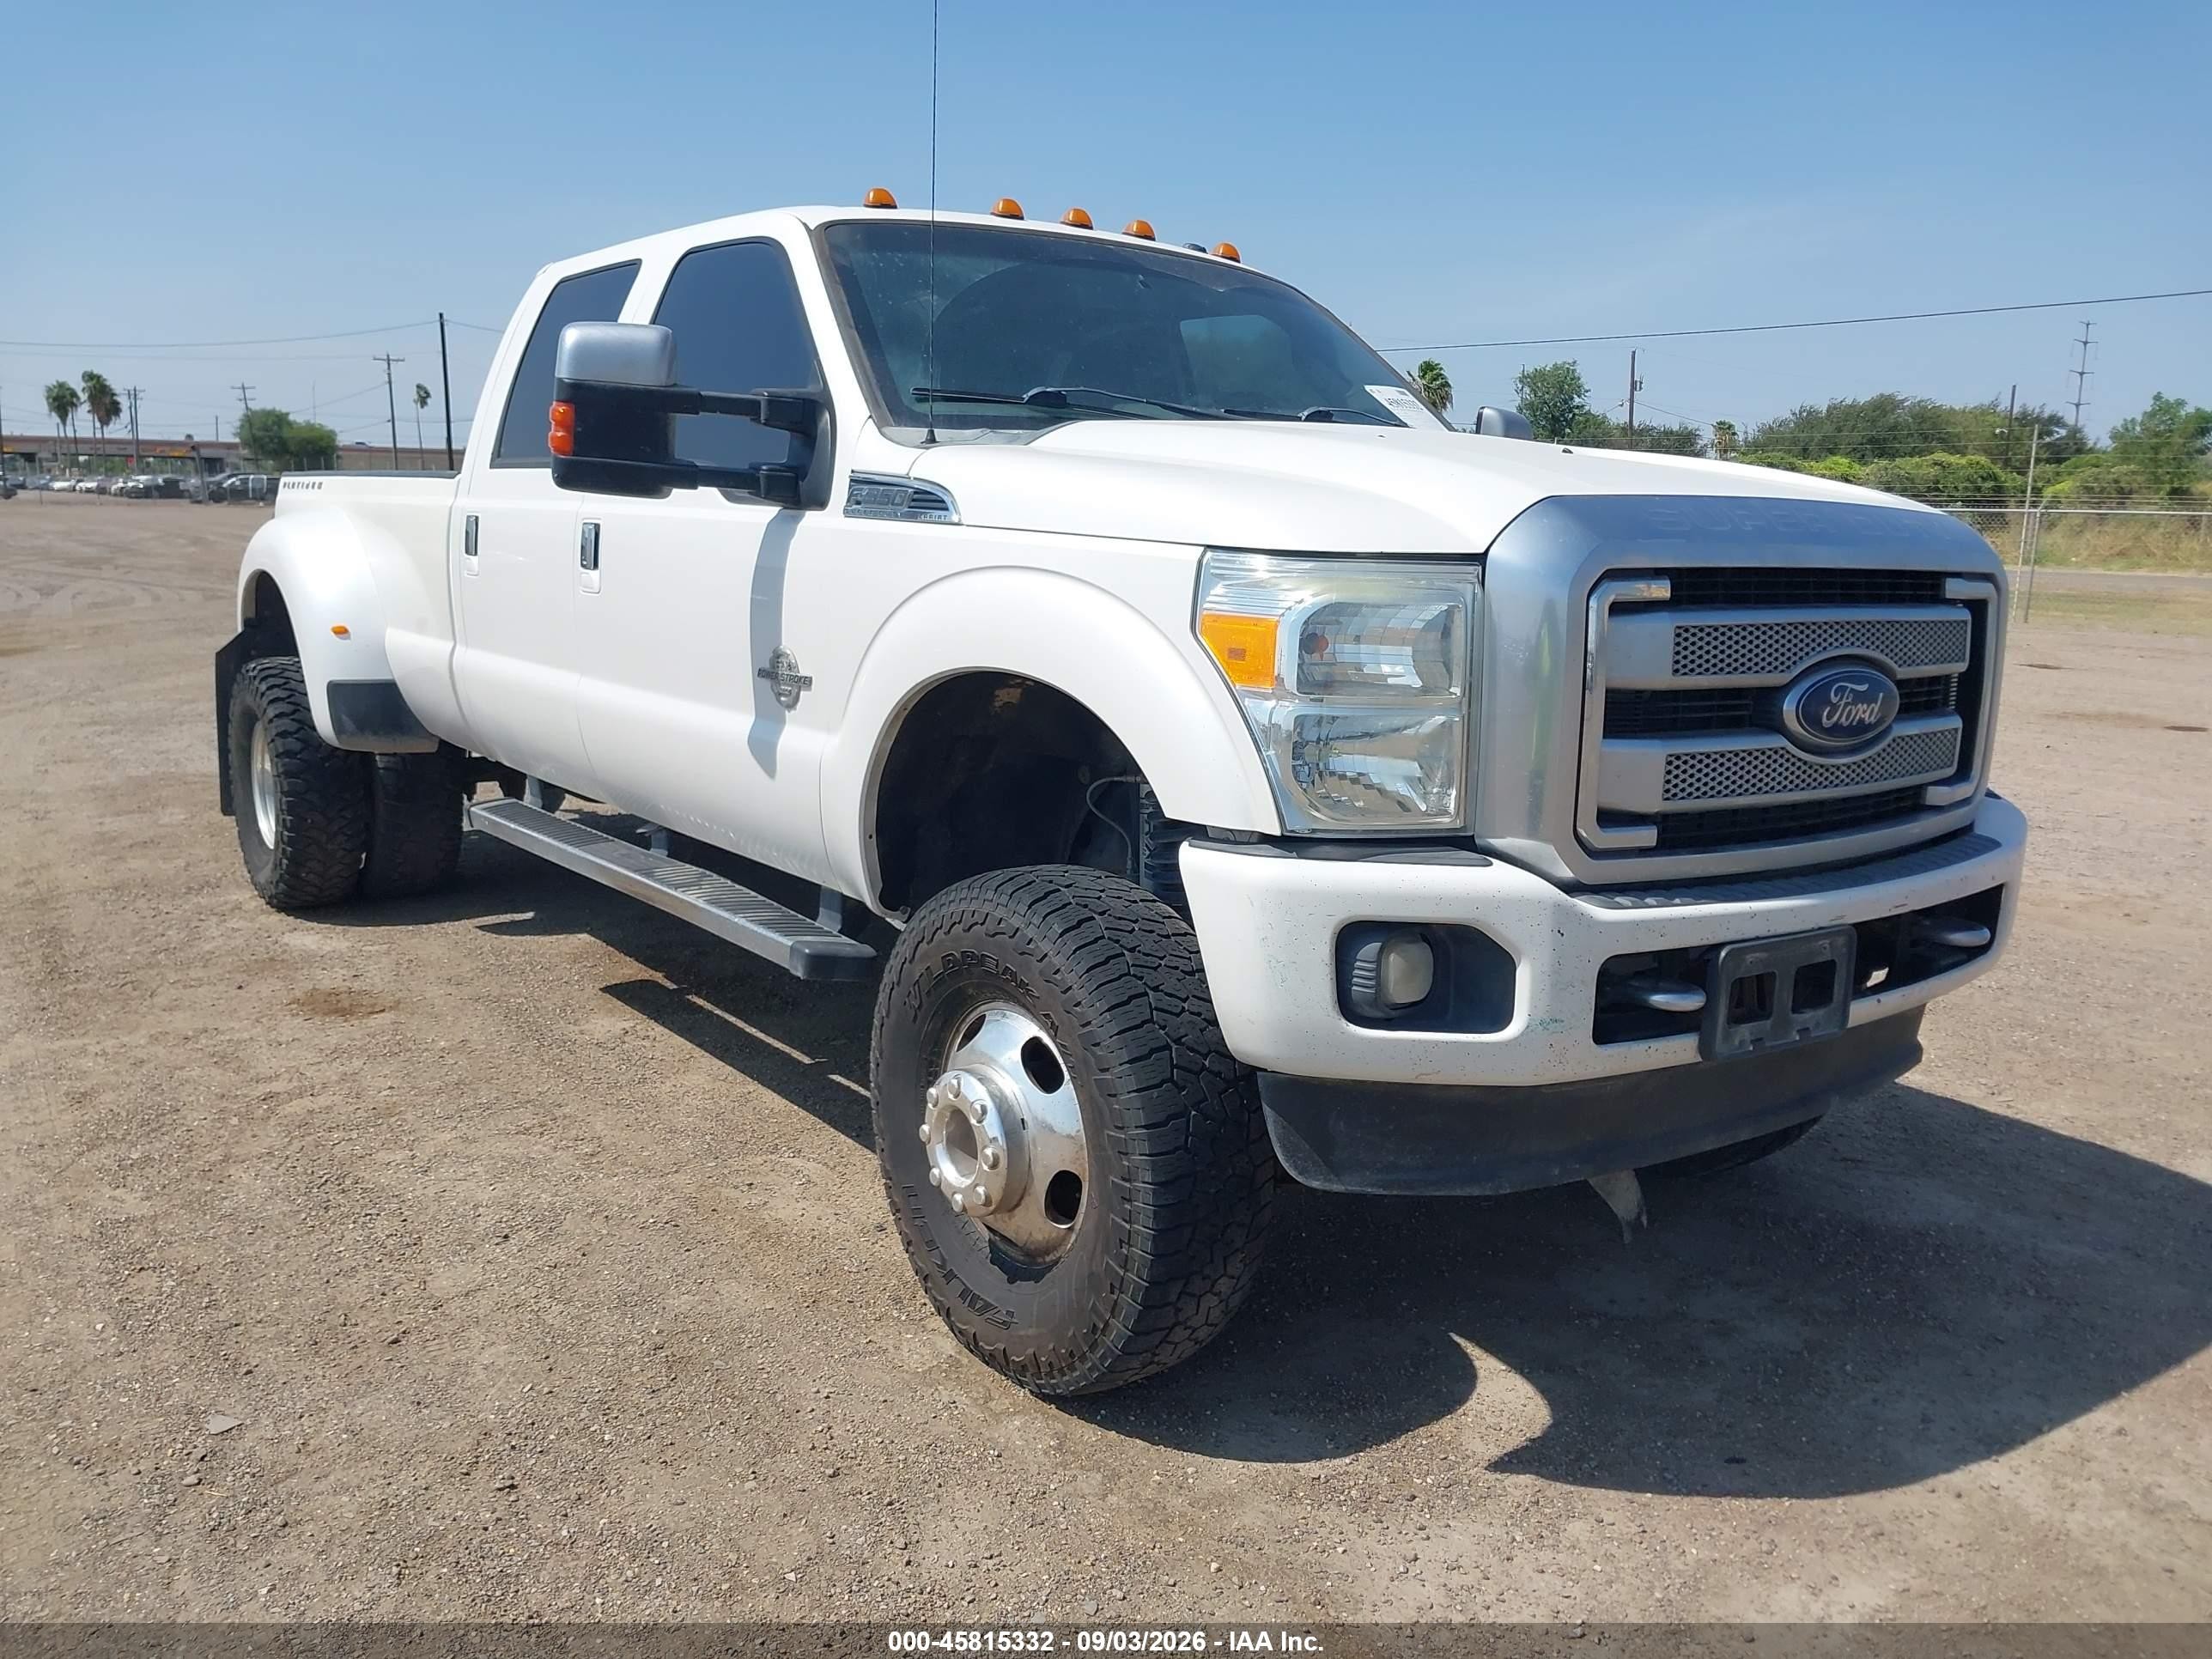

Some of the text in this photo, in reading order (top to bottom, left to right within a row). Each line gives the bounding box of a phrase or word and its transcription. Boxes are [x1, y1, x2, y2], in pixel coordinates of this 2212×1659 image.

[757, 667, 809, 685] POWER STROKE
[1821, 682, 1884, 728] Ford
[903, 948, 1041, 1024] WILDPEAK
[901, 1184, 1019, 1330] FALKEN
